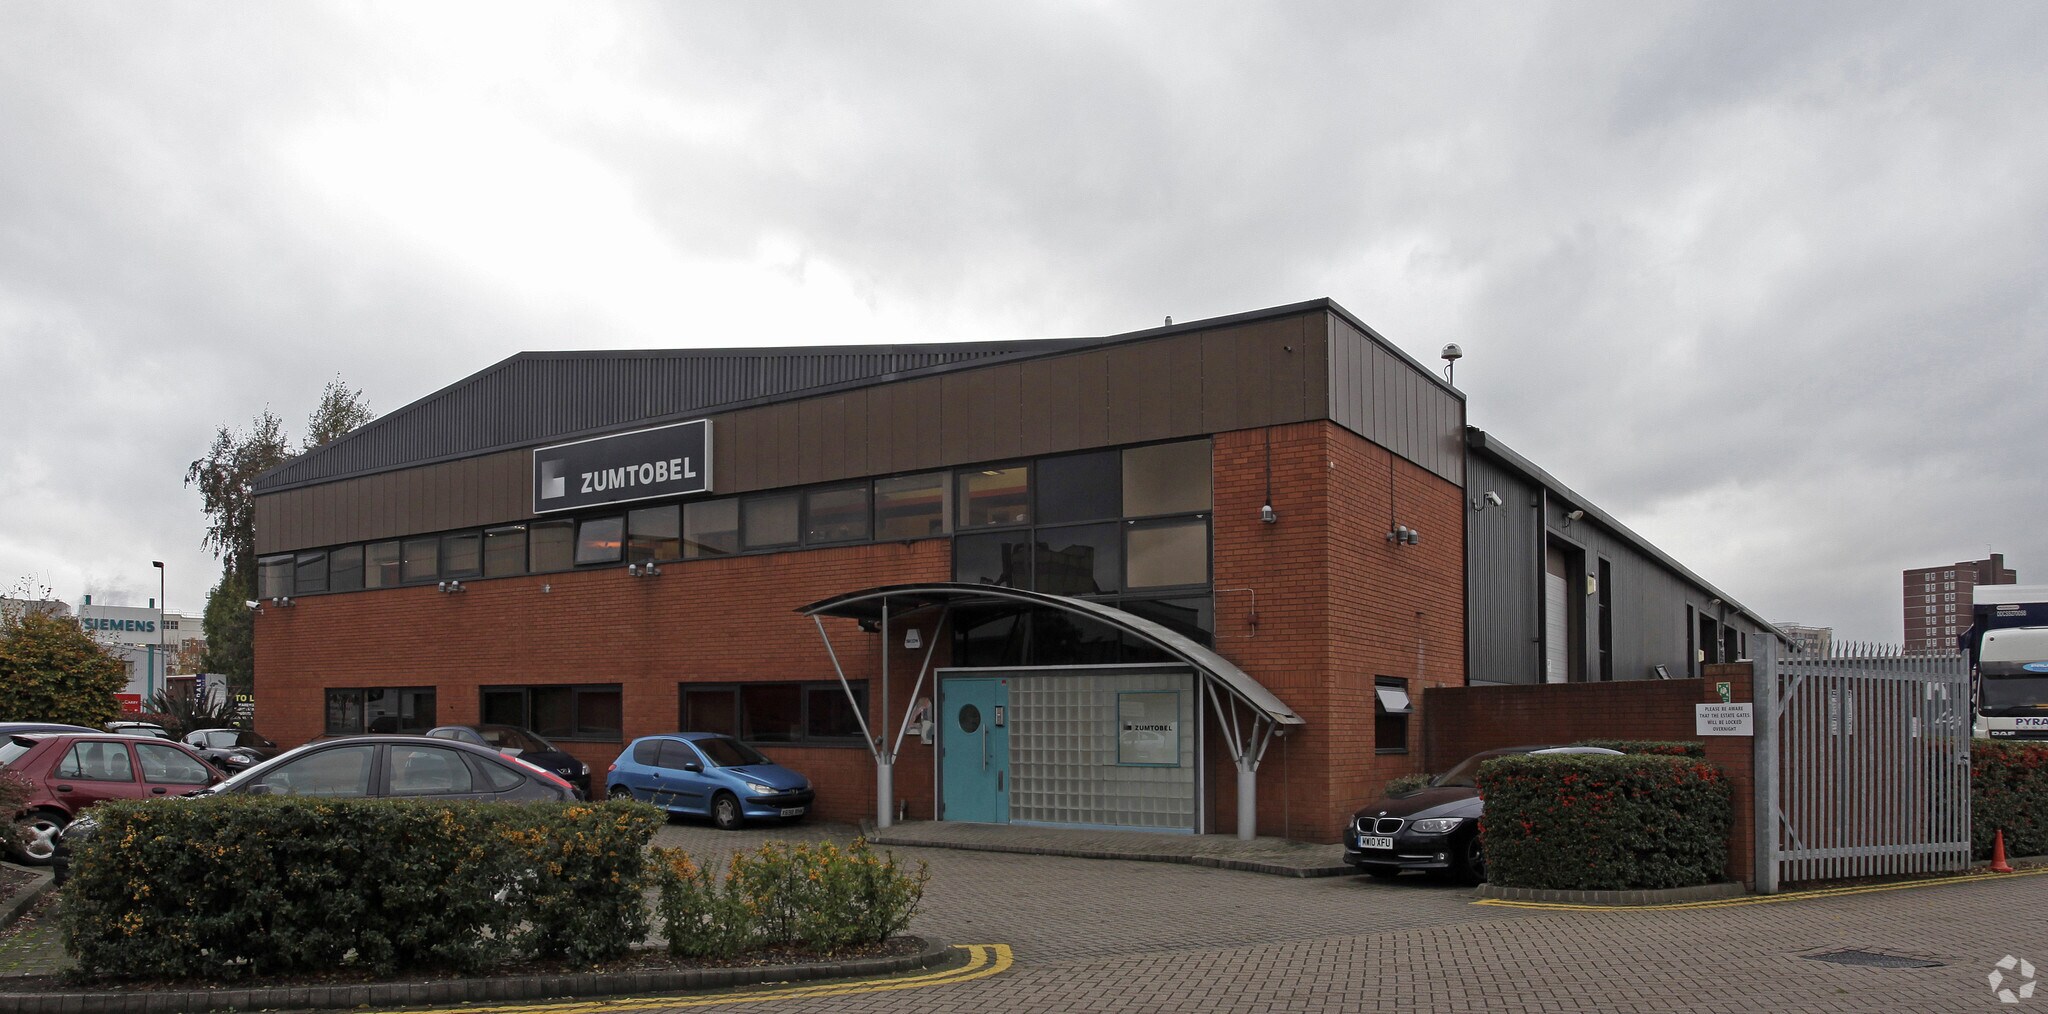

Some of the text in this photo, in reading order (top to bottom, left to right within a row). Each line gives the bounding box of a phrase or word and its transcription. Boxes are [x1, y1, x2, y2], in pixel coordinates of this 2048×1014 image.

[580, 457, 697, 494] ZUMTOBEL
[84, 617, 156, 633] SIEMENS
[235, 694, 247, 702] TO
[1377, 838, 1391, 848] XFU
